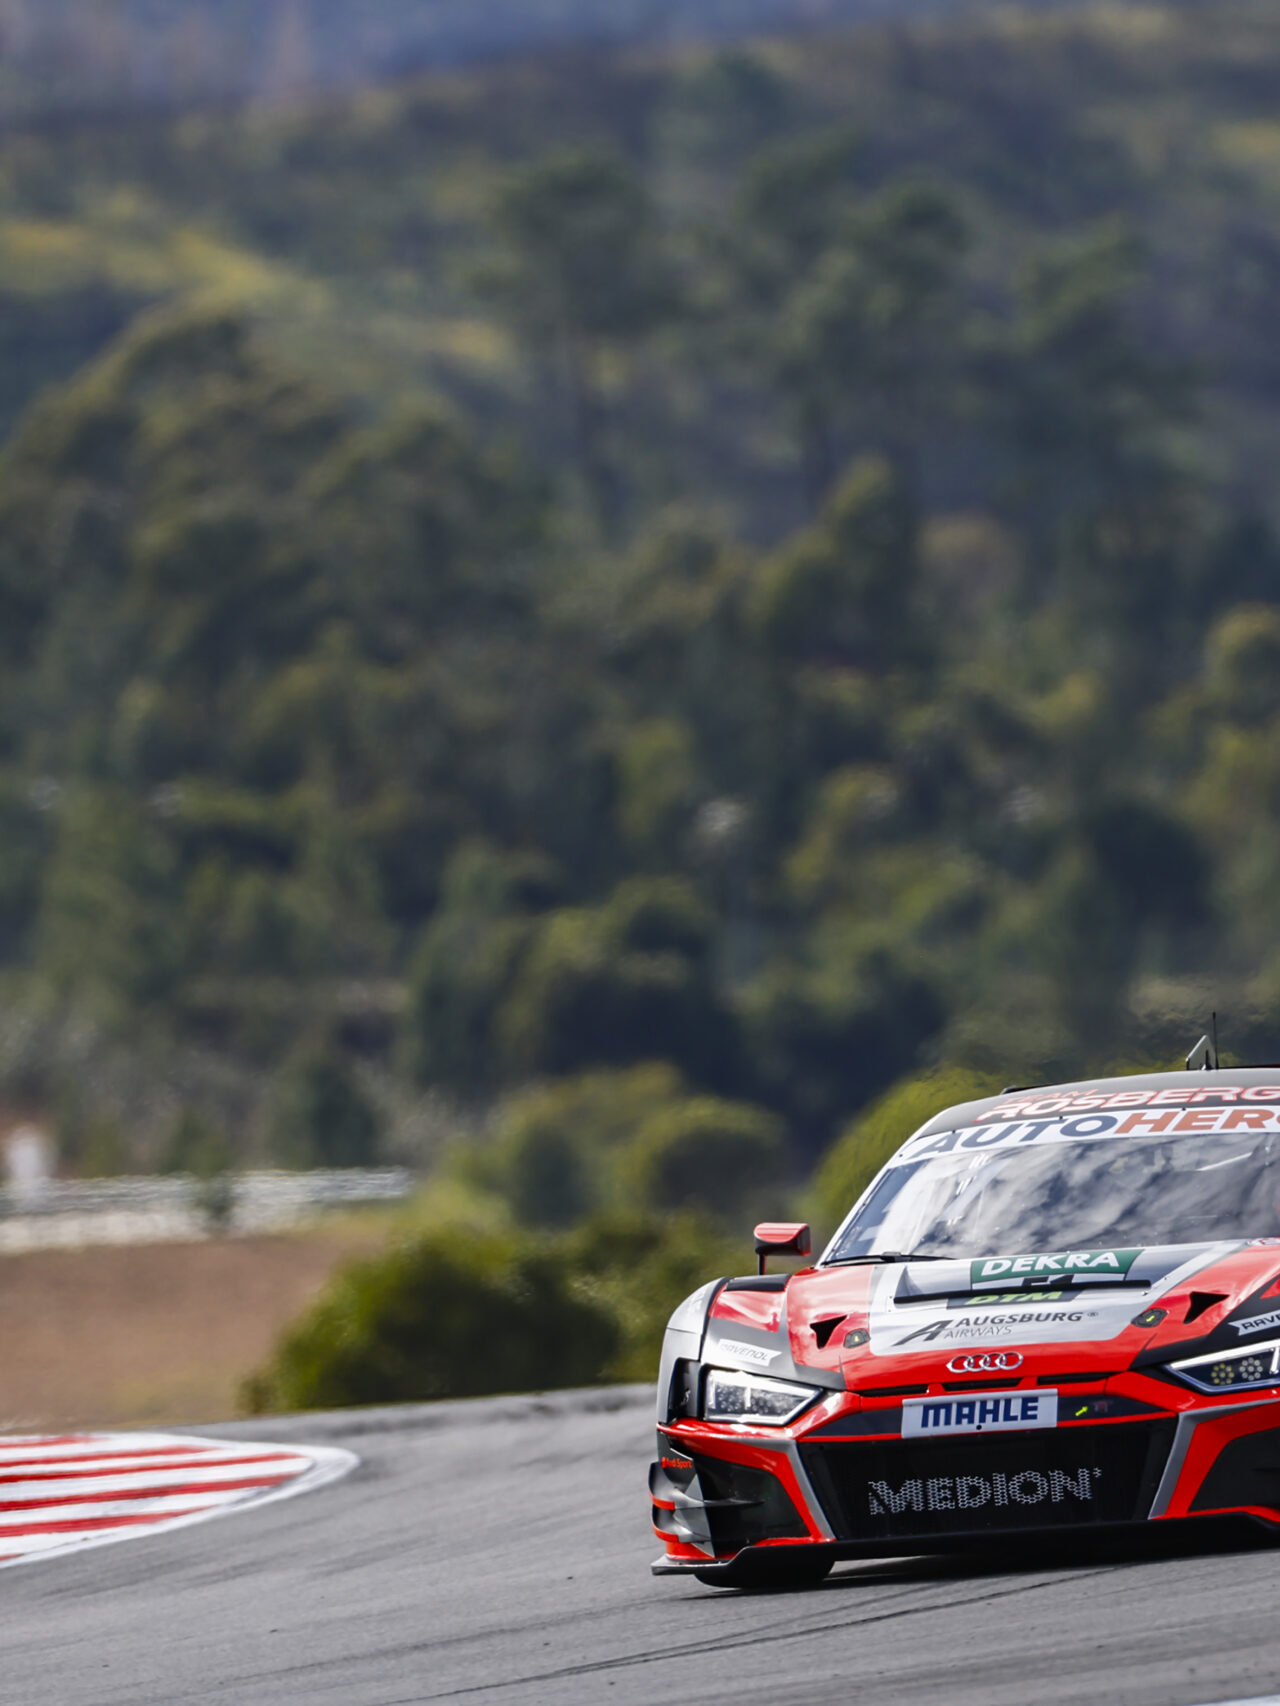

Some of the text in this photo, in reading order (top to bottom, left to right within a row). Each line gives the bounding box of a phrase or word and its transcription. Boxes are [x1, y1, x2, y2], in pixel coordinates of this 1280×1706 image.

[980, 1251, 1120, 1276] DEKRA
[963, 1290, 1064, 1305] DTM
[955, 1311, 1084, 1328] AUGSBURG
[944, 1324, 1013, 1340] AIRWAYS
[921, 1396, 1039, 1428] MAHLE
[868, 1468, 1093, 1515] MEDION
